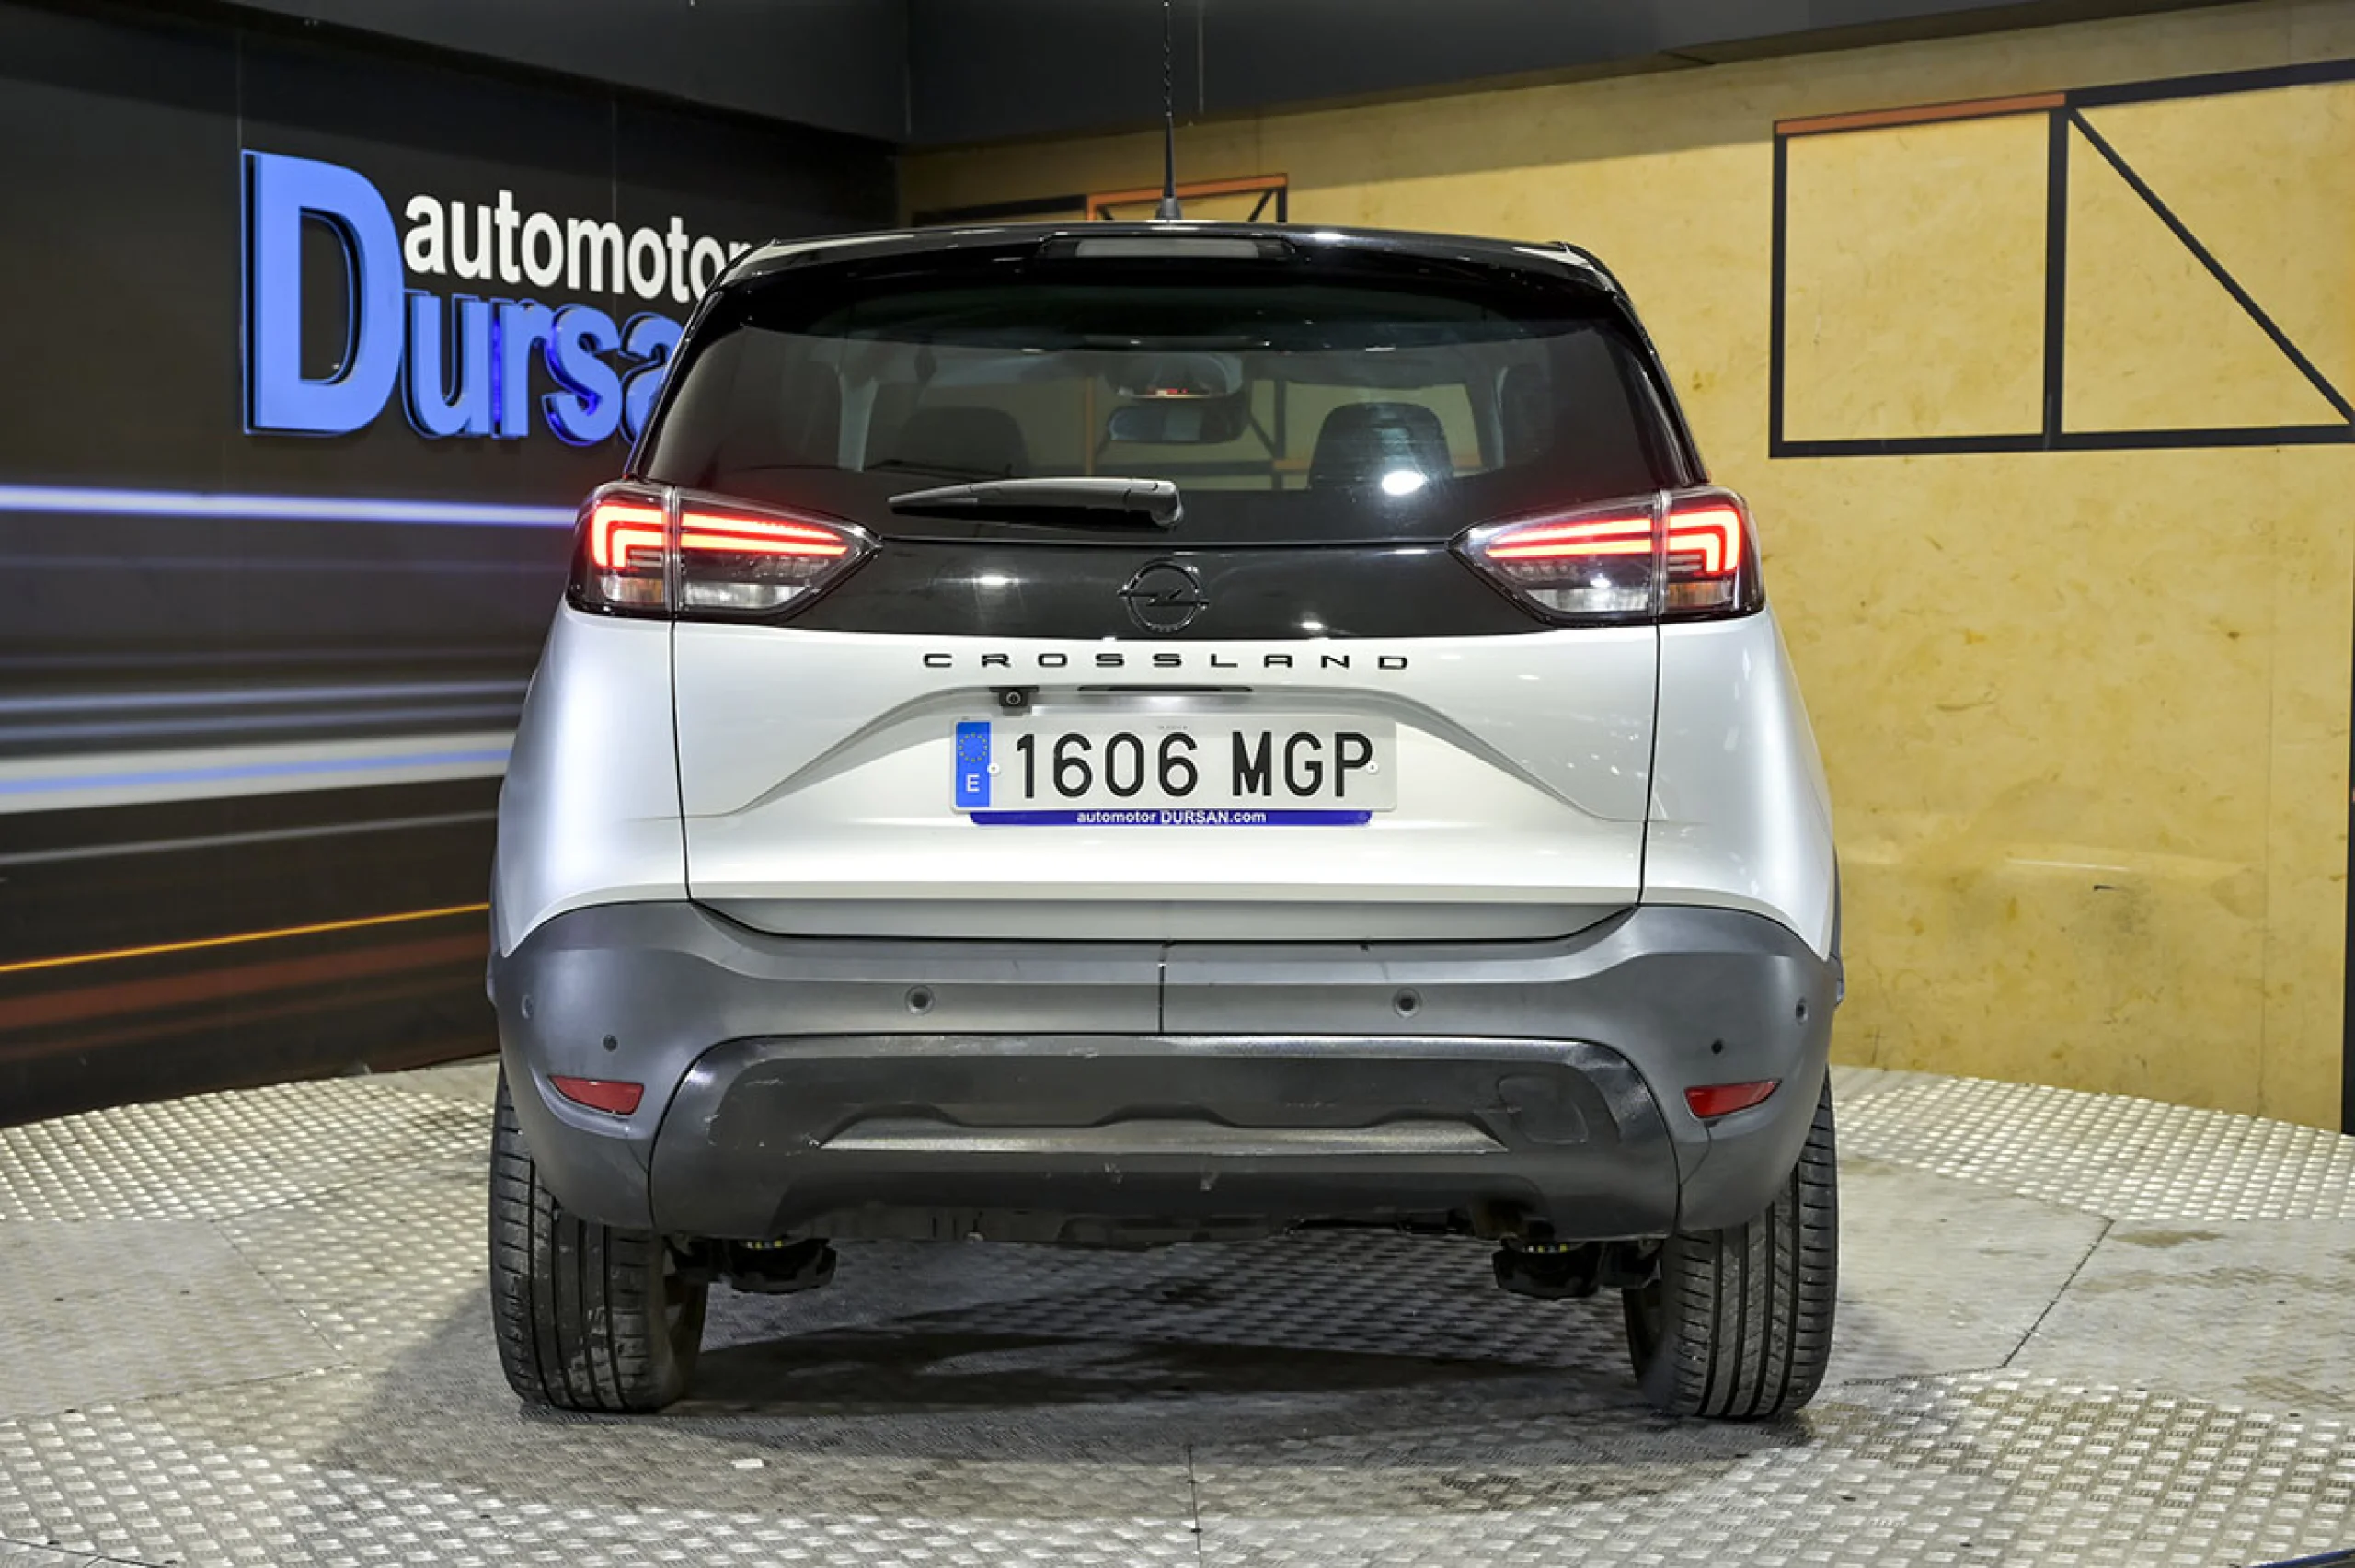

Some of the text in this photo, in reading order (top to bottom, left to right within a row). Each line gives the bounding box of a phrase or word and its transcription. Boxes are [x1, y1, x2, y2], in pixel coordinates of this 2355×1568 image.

[923, 653, 1408, 670] CROSSLAND
[1016, 731, 1373, 798] 1606 MGP
[966, 774, 980, 792] E
[1076, 810, 1267, 824] automotor DURSAN.com
